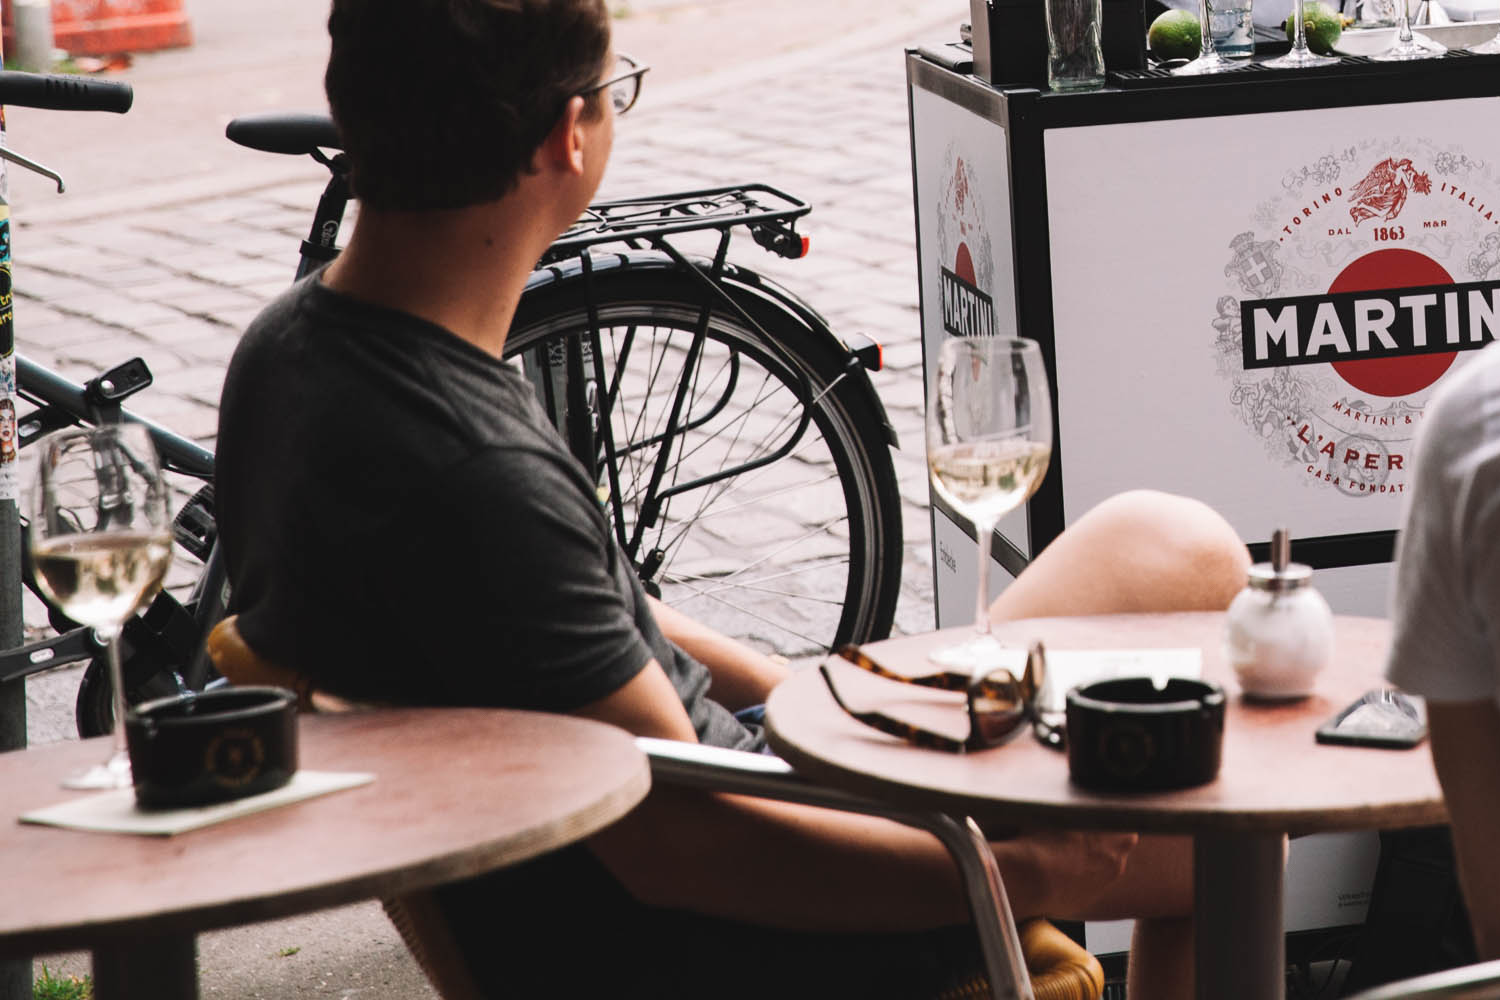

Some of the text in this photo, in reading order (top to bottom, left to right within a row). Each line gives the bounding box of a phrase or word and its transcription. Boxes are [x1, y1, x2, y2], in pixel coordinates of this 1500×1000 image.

[1328, 219, 1447, 241] DAL 1863 M&R
[943, 274, 993, 338] MARTINI
[1332, 400, 1395, 426] MARTINI
[1297, 424, 1404, 470] L'APER
[1306, 465, 1405, 493] CASA FONDAT
